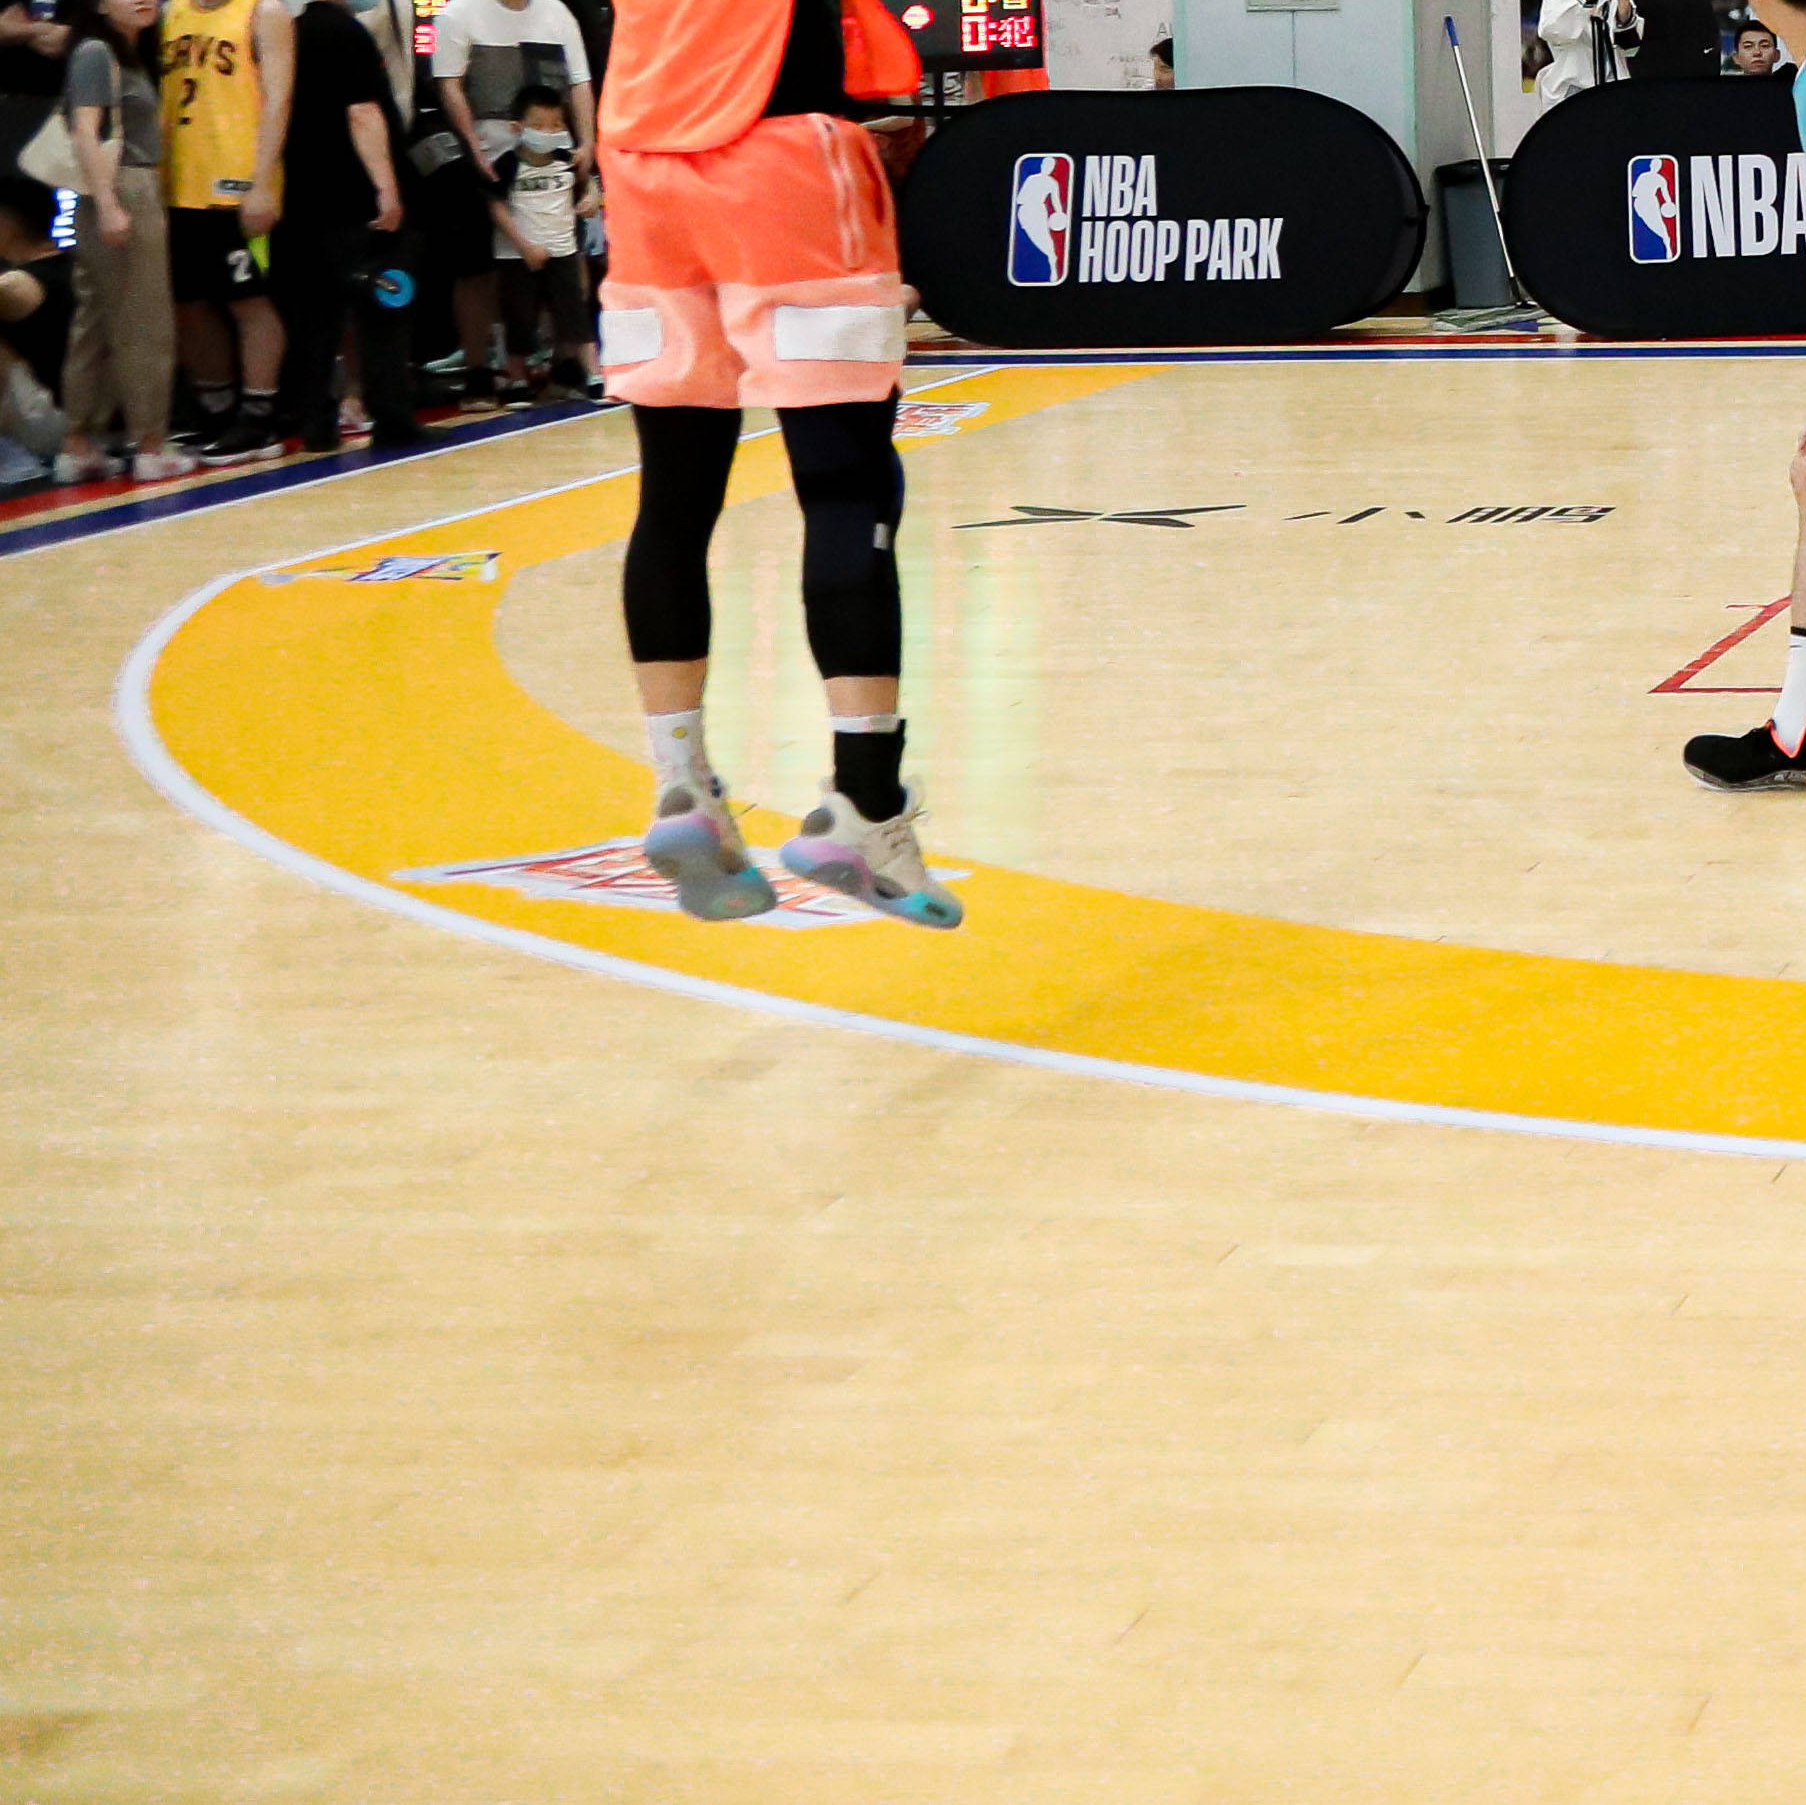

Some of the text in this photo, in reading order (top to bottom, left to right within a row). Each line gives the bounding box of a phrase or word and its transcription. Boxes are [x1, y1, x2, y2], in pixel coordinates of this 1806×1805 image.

[1081, 155, 1158, 217] NBA
[1078, 217, 1284, 284] HOOP PARK
